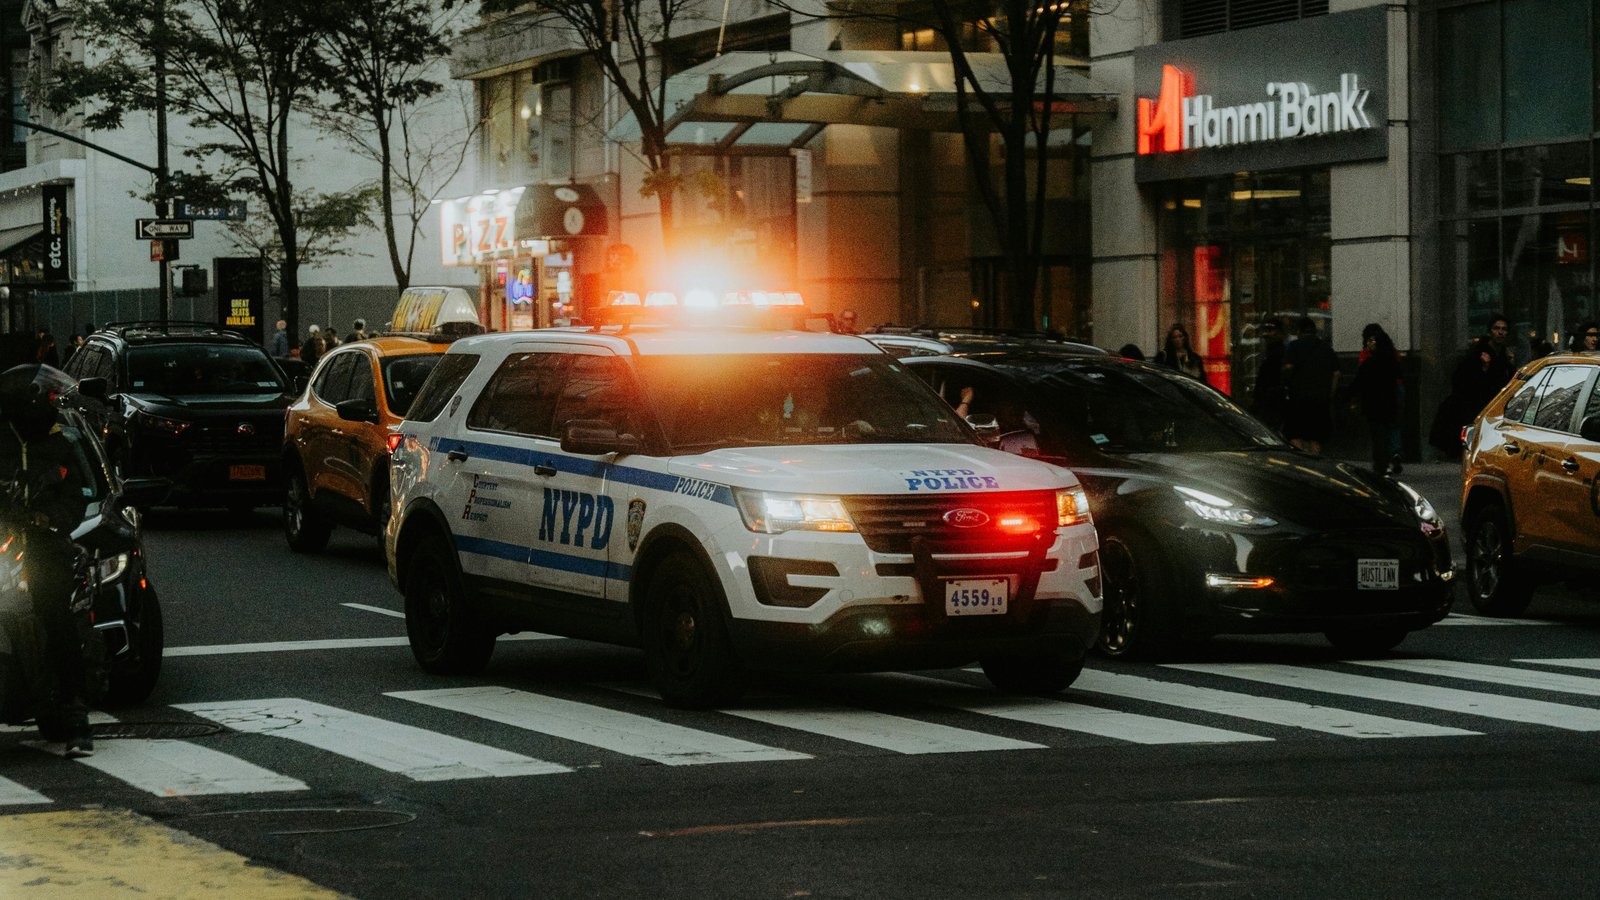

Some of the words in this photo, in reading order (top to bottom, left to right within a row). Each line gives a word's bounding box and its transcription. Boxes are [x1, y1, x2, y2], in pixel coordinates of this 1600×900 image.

[1183, 82, 1276, 150] Hanmi
[1279, 73, 1370, 139] Bank
[148, 224, 162, 232] ONE
[50, 237, 62, 269] etc.
[231, 308, 249, 317] SEATS
[226, 316, 255, 326] AVAILABLE
[910, 469, 975, 477] NYPD
[674, 477, 716, 500] POLICE
[905, 476, 999, 491] POLICE
[538, 487, 615, 550] NYPD
[955, 510, 979, 522] Ford
[951, 589, 989, 607] 4559
[991, 596, 1002, 606] 18
